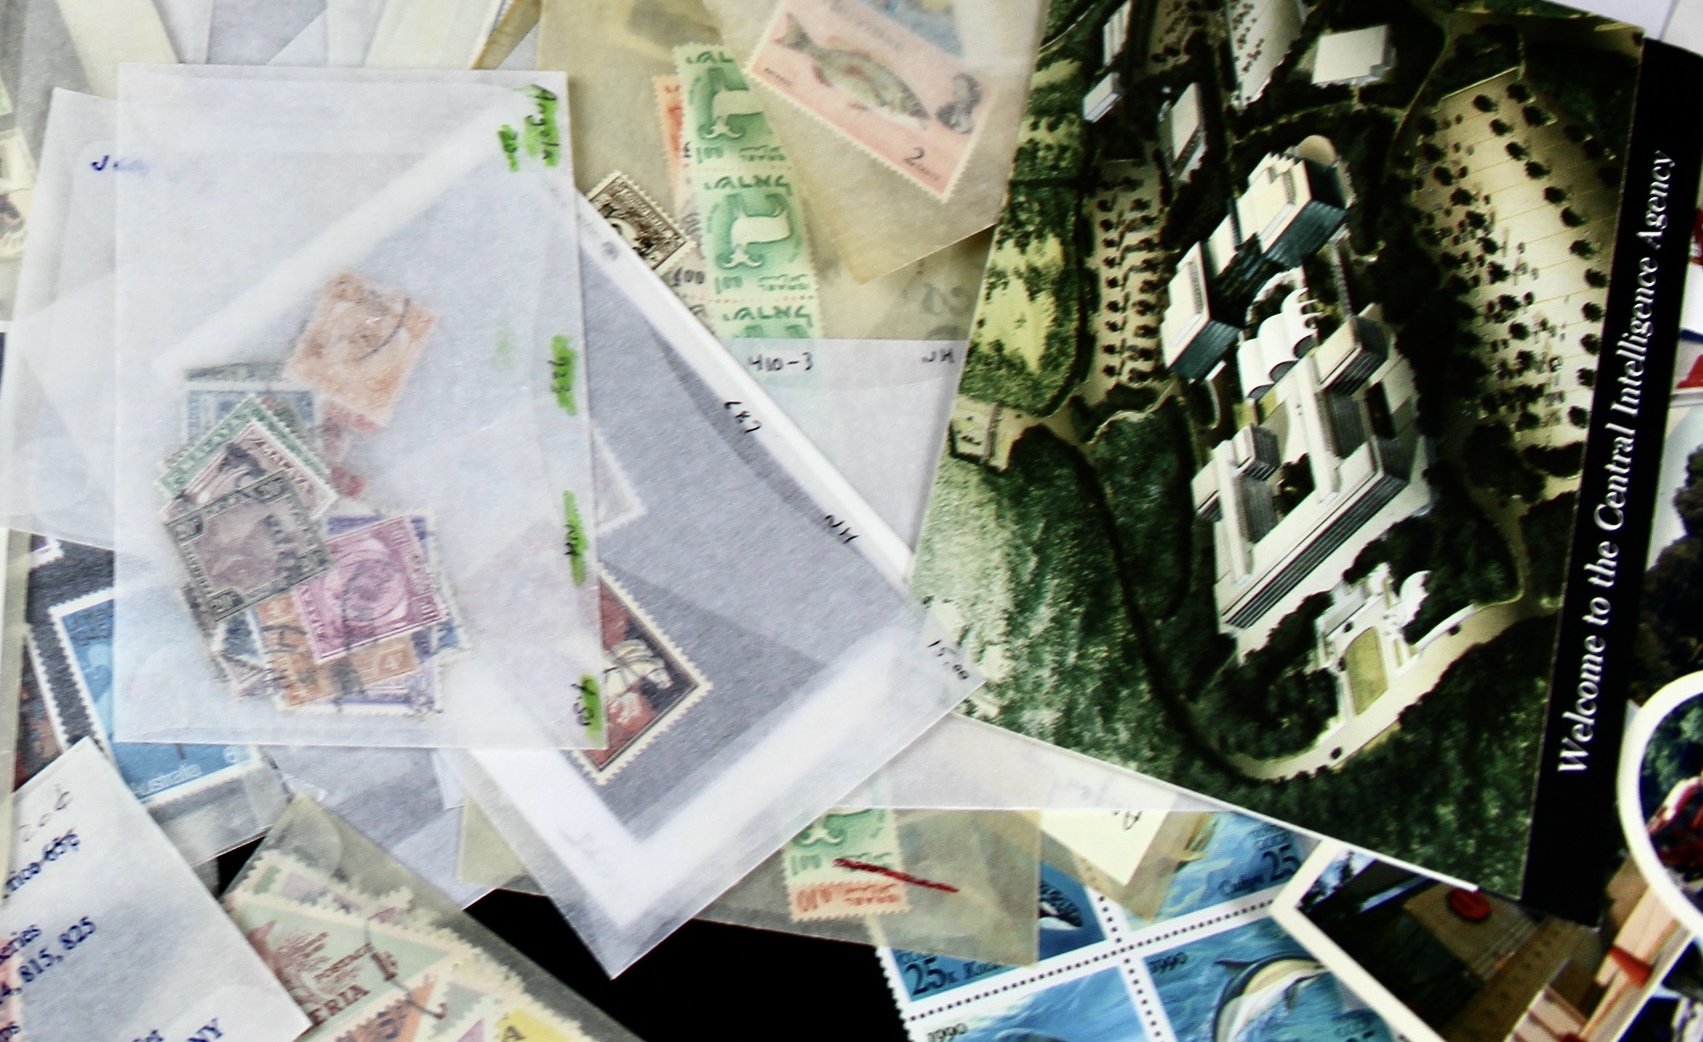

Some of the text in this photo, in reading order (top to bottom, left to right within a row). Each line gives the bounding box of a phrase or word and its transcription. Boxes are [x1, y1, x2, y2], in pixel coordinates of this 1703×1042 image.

[1556, 148, 1678, 776] Welcome to the Central Intelligence Agency
[19, 948, 65, 985] 815,
[58, 915, 99, 950] 825
